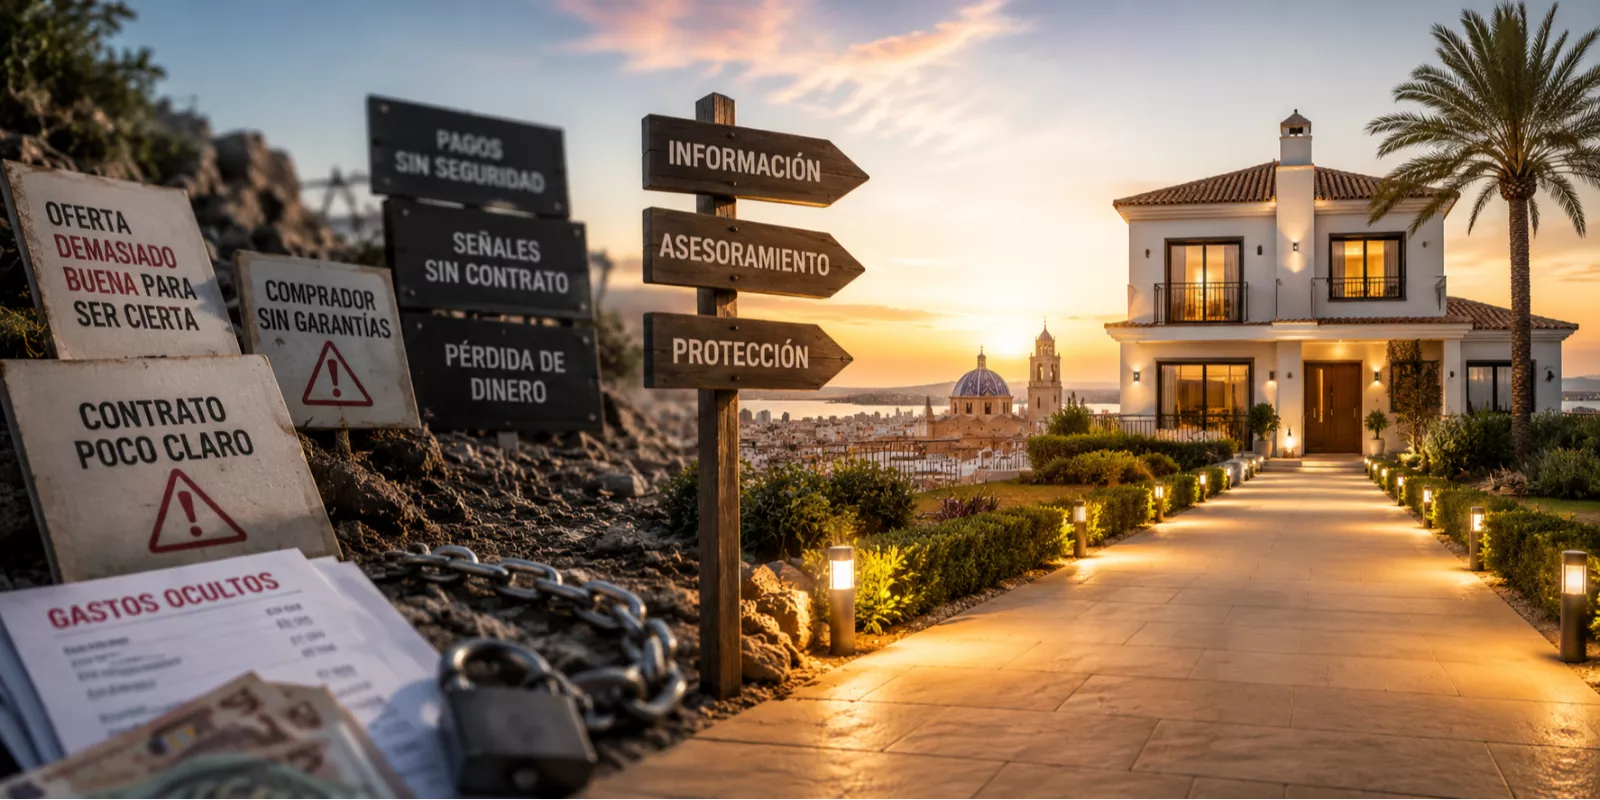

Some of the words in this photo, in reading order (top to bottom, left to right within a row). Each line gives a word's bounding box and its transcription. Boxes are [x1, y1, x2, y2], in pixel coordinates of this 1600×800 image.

[436, 129, 504, 160] PAGOS
[668, 140, 821, 182] INFORMACIÓN
[395, 151, 430, 175] SIN
[434, 156, 545, 194] SEGURIDAD
[45, 201, 132, 235] OFERTA
[54, 233, 177, 269] DEMASIADO
[453, 231, 541, 263] SEÑALES
[659, 233, 830, 276] ASESORAMIENTO
[63, 266, 139, 296] BUENA
[141, 273, 198, 300] PARA
[425, 260, 460, 284] SIN
[465, 263, 569, 294] CONTRATO
[265, 279, 377, 311] COMPRADOR
[73, 301, 121, 328] SER
[124, 303, 200, 331] CIERTA
[258, 307, 290, 331] SIN
[294, 311, 391, 339] GARANTÍAS
[445, 340, 534, 372] PÉRDIDA
[540, 350, 566, 373] DE
[672, 338, 809, 369] PROTECCIÓN
[471, 378, 547, 404] DINERO
[79, 396, 226, 430] CONTRATO
[74, 436, 157, 469] POCO
[163, 429, 254, 462] CLARO
[47, 593, 159, 629] GASTOS
[163, 572, 279, 608] OCULTOS
